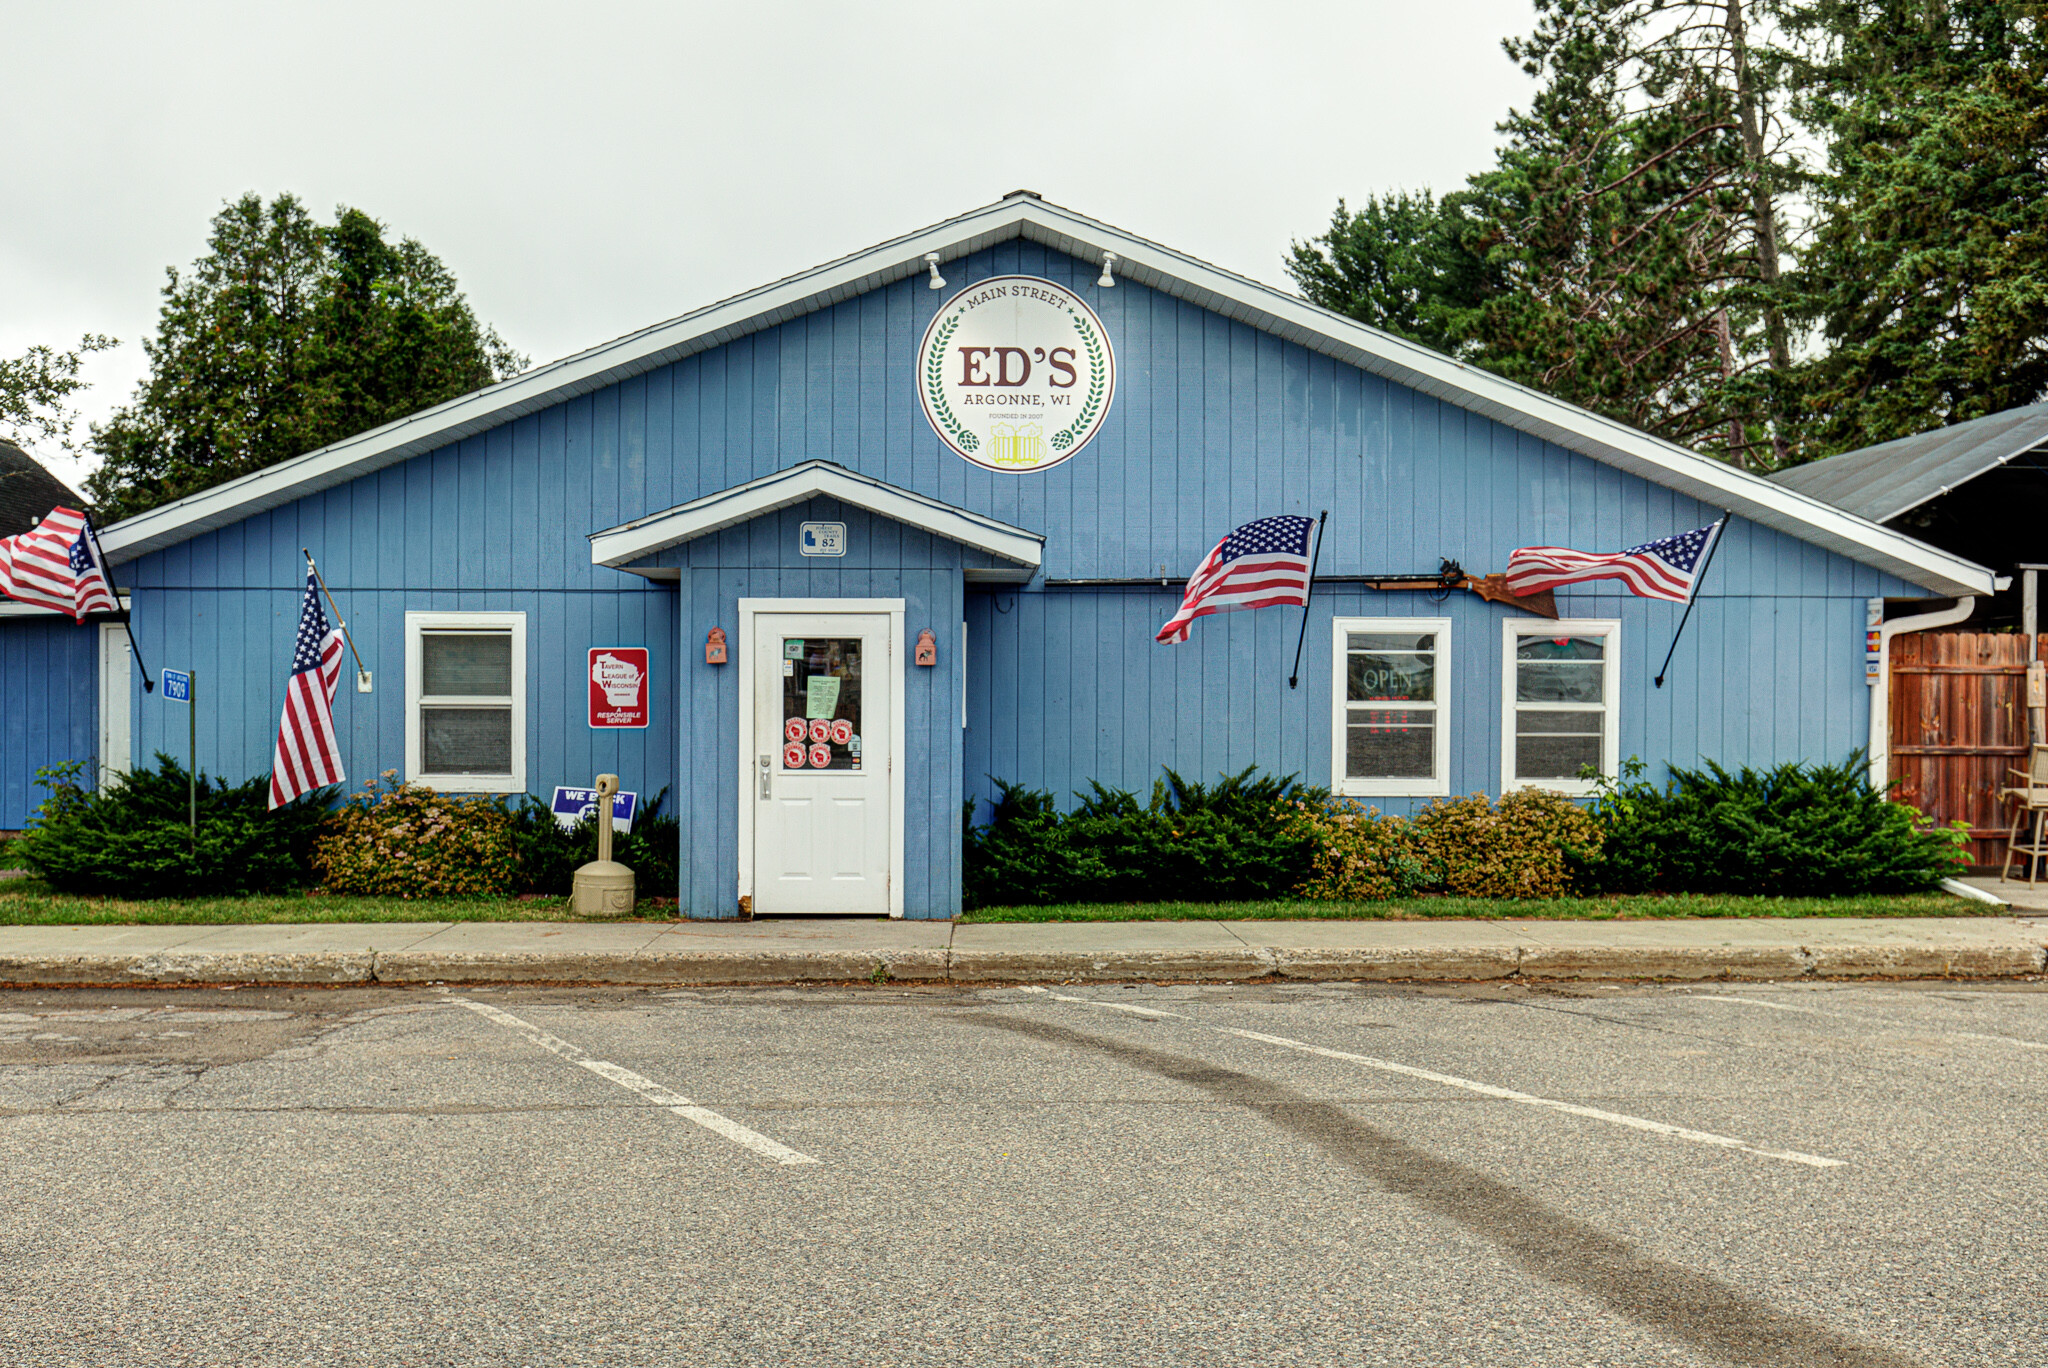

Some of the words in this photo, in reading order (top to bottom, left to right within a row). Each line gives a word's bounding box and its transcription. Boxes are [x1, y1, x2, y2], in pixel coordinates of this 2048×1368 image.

[966, 286, 1007, 310] MAIN
[1011, 285, 1067, 310] STREET
[957, 346, 1077, 388] ED'S
[963, 394, 1045, 408] ARGONNE,
[1051, 394, 1071, 406] WI
[822, 538, 835, 547] 82
[600, 661, 624, 669] TAVERN
[601, 670, 627, 679] LEAGUE
[1363, 669, 1412, 690] OPEN
[168, 680, 186, 698] 7909
[602, 680, 638, 689] WISCONSIN
[597, 711, 642, 719] RESPONSIBLE
[565, 790, 586, 801] WE
